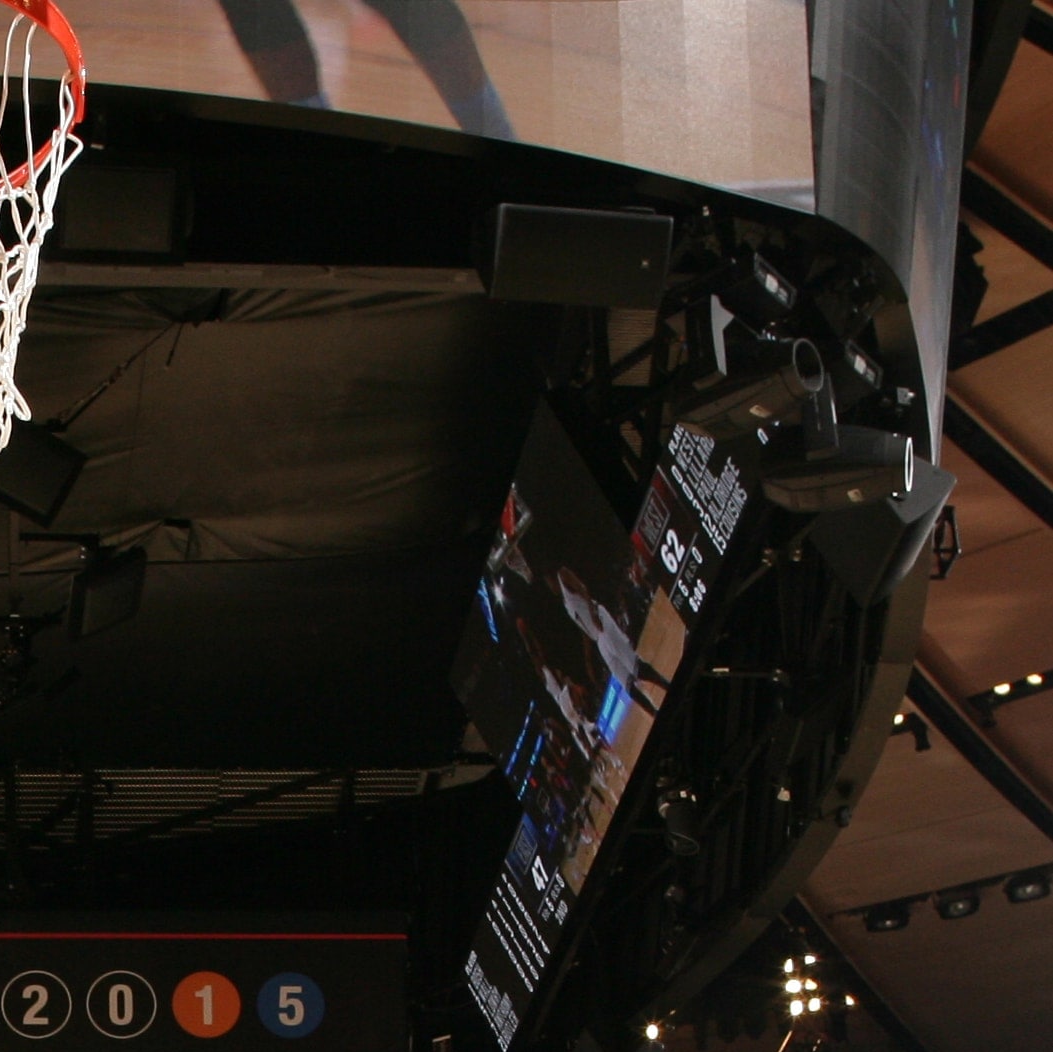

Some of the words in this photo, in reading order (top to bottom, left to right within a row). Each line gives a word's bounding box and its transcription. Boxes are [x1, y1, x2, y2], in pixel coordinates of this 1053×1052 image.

[660, 529, 685, 574] 62
[531, 855, 549, 891] 47
[22, 984, 49, 1026] 2
[108, 984, 134, 1026] 0
[194, 984, 213, 1026] 1
[278, 985, 305, 1027] 5
